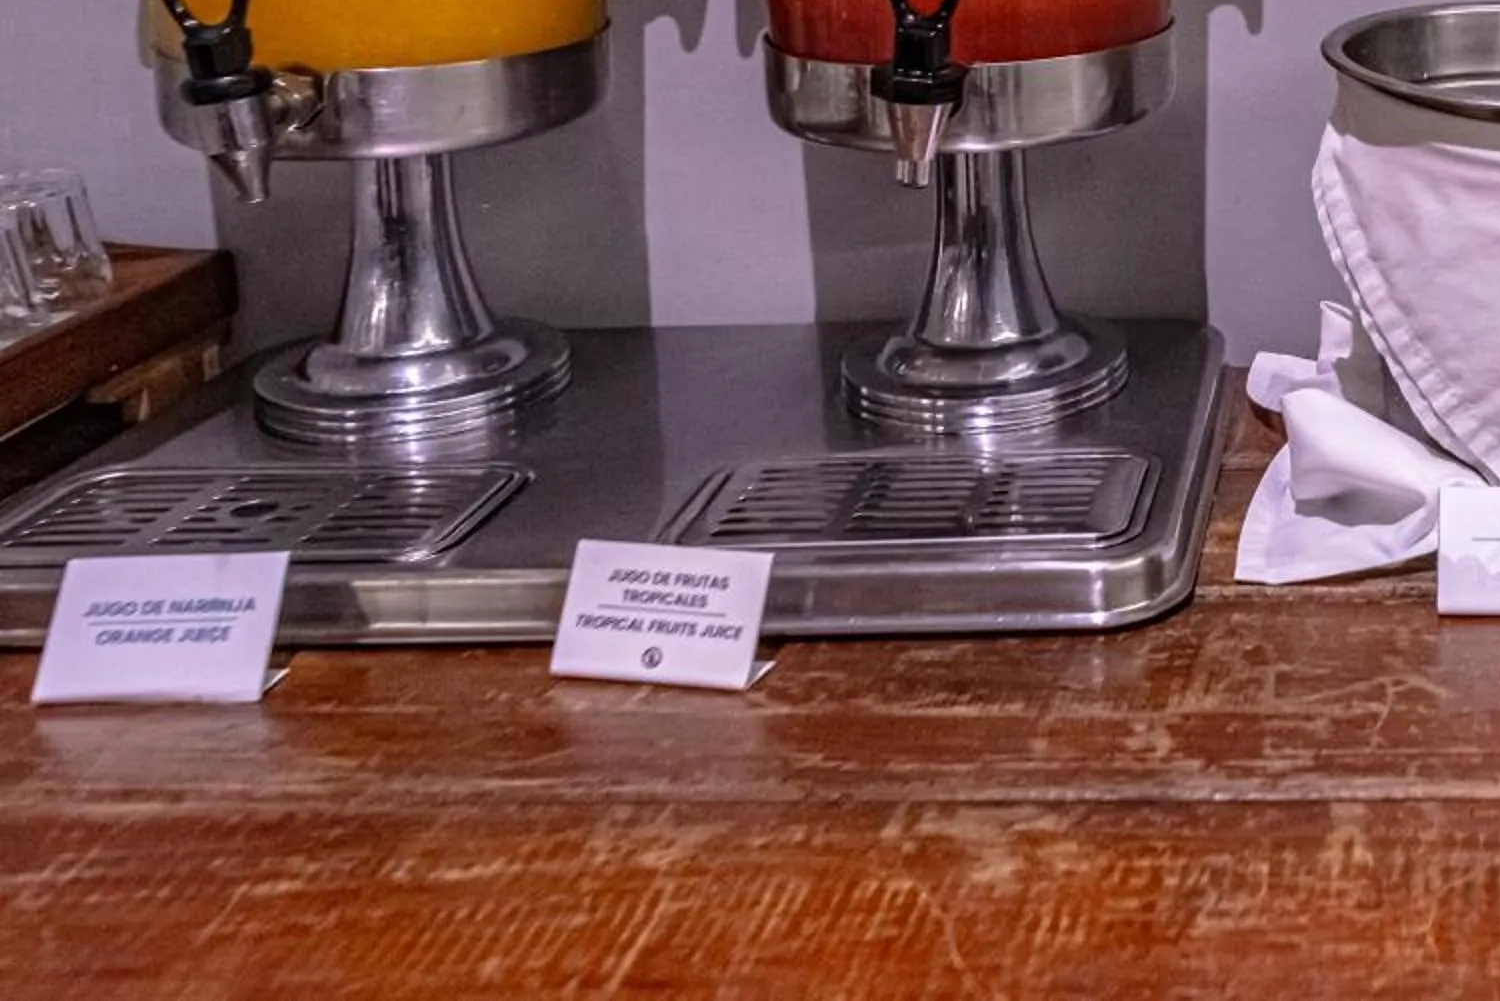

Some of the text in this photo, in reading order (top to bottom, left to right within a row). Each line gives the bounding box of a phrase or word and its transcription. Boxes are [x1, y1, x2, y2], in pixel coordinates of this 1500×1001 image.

[608, 569, 730, 591] JUGO DE FRUTAS
[141, 599, 165, 615] DE
[623, 589, 709, 609] TROPICALES
[95, 625, 232, 645] ORANGE JUICE
[576, 614, 744, 642] TROPICAL FRUITS JUICE
